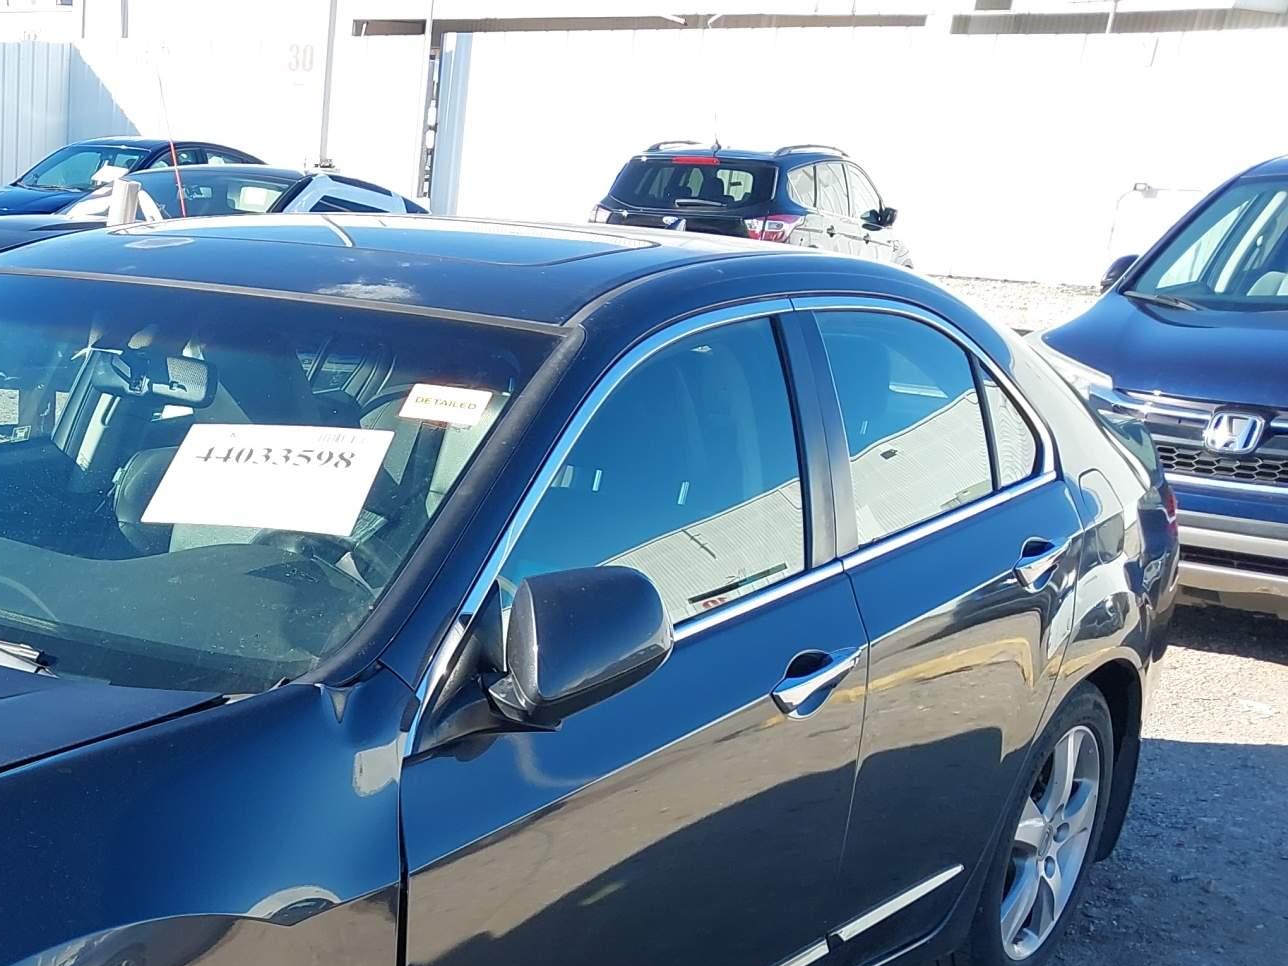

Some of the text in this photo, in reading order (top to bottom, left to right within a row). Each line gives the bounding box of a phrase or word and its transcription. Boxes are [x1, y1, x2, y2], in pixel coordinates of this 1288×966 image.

[288, 43, 314, 72] 30
[415, 395, 477, 410] DETAILED
[196, 446, 356, 469] 44033598
